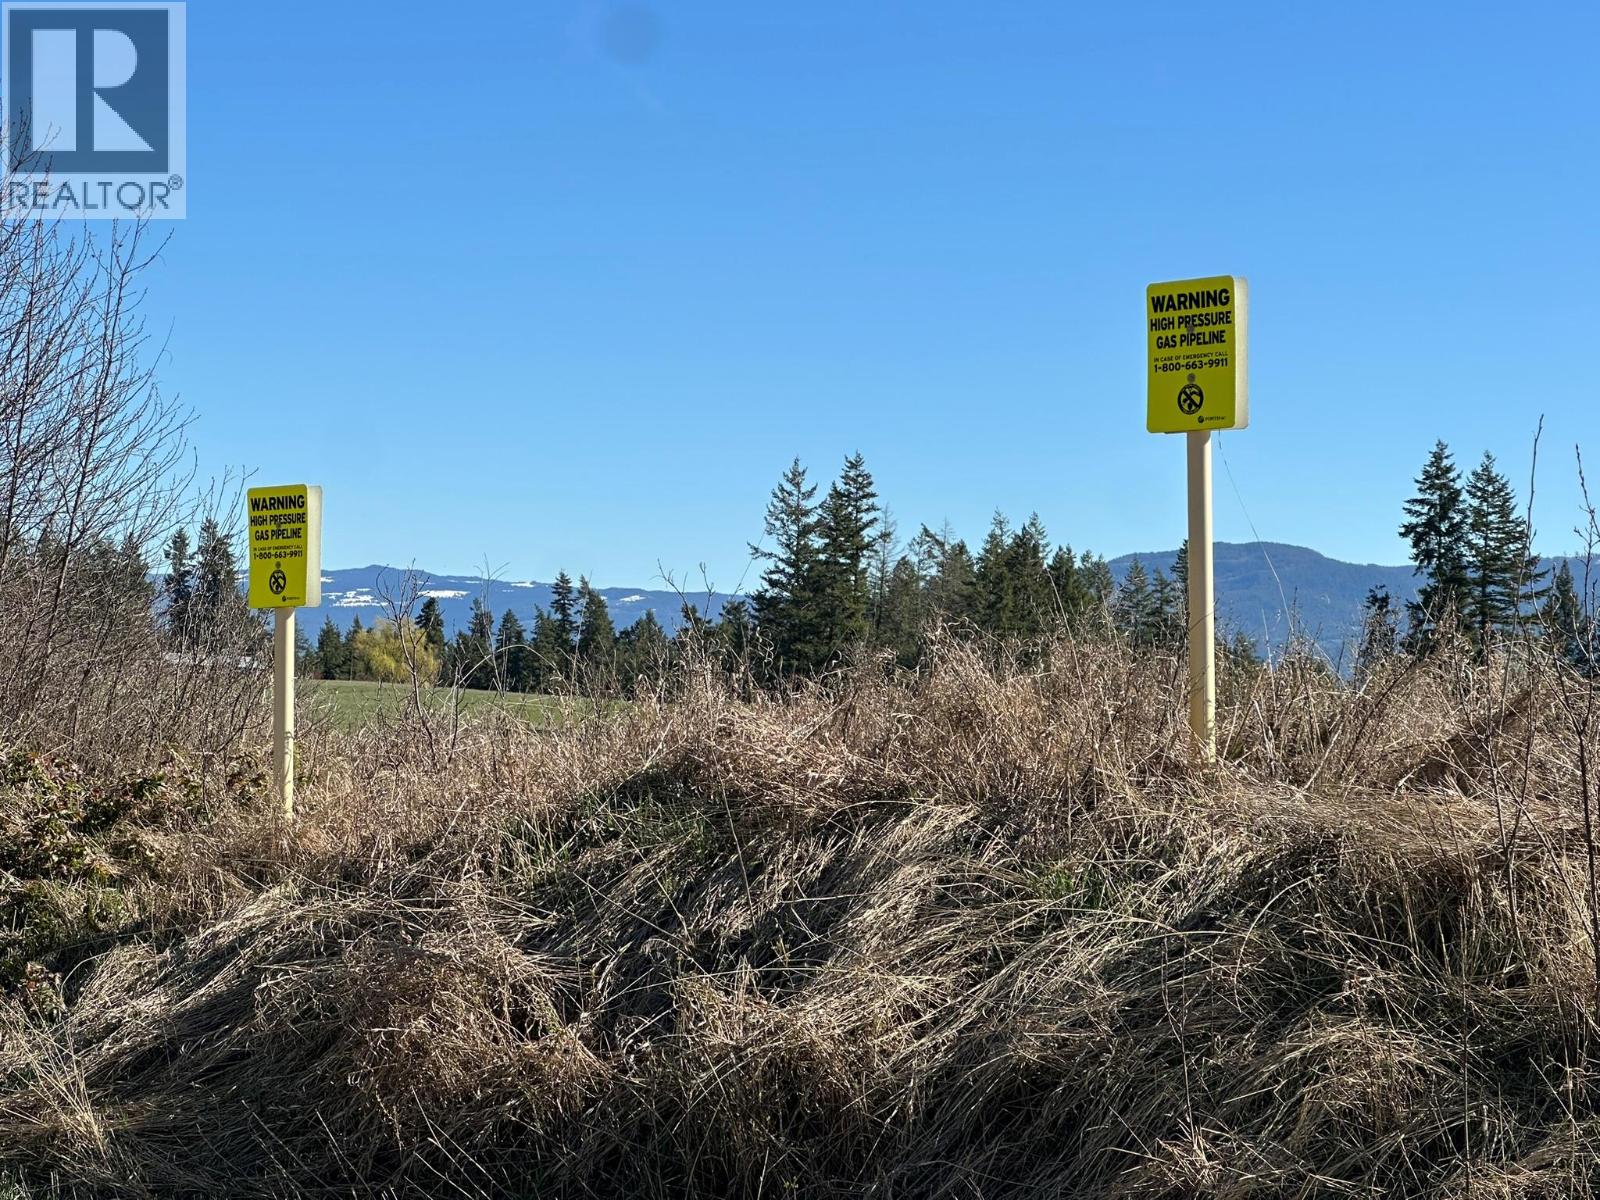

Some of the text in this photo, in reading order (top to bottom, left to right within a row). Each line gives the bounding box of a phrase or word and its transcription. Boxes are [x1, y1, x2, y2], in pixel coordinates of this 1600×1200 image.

[1151, 288, 1230, 313] WARNING
[1150, 311, 1232, 332] HIGH PRESSURE
[1156, 330, 1226, 350] GAS PIPELINE
[1183, 352, 1214, 360] EMERGENCY
[1154, 358, 1228, 373] 1-800-663-9911
[250, 494, 305, 512] WARNING
[250, 512, 306, 527] HIGH PRESSURE
[254, 527, 302, 541] GAS PIPELINE
[253, 550, 303, 560] 1-800-663-9911
